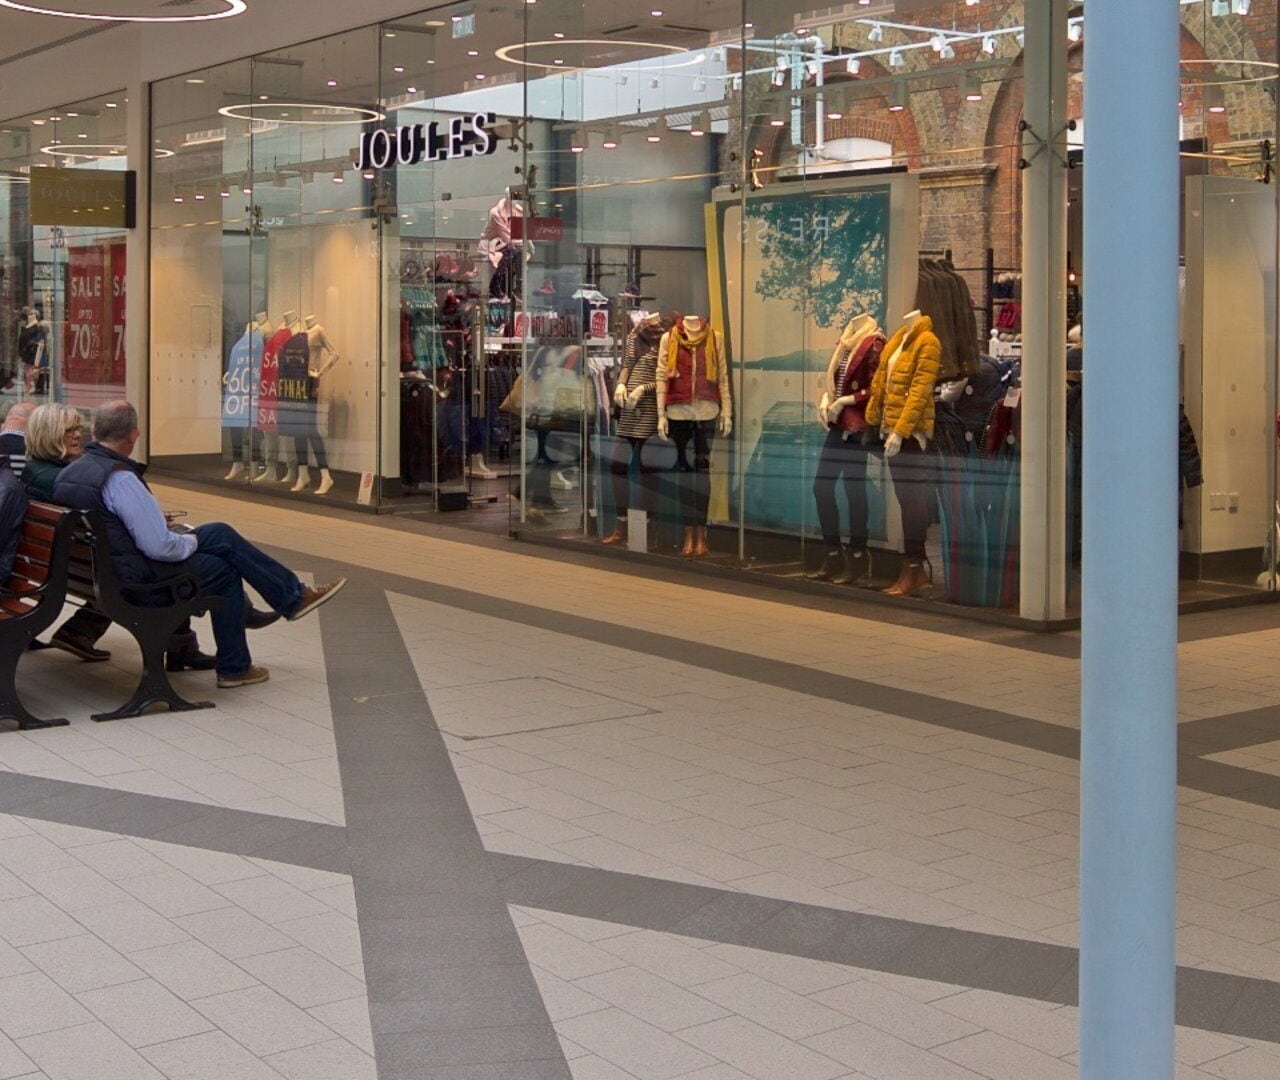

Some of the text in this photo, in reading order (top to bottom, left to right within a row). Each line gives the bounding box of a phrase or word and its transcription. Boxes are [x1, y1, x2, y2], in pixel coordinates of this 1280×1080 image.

[352, 112, 496, 171] JOULES
[71, 276, 102, 297] SALE
[277, 379, 308, 399] FINAL
